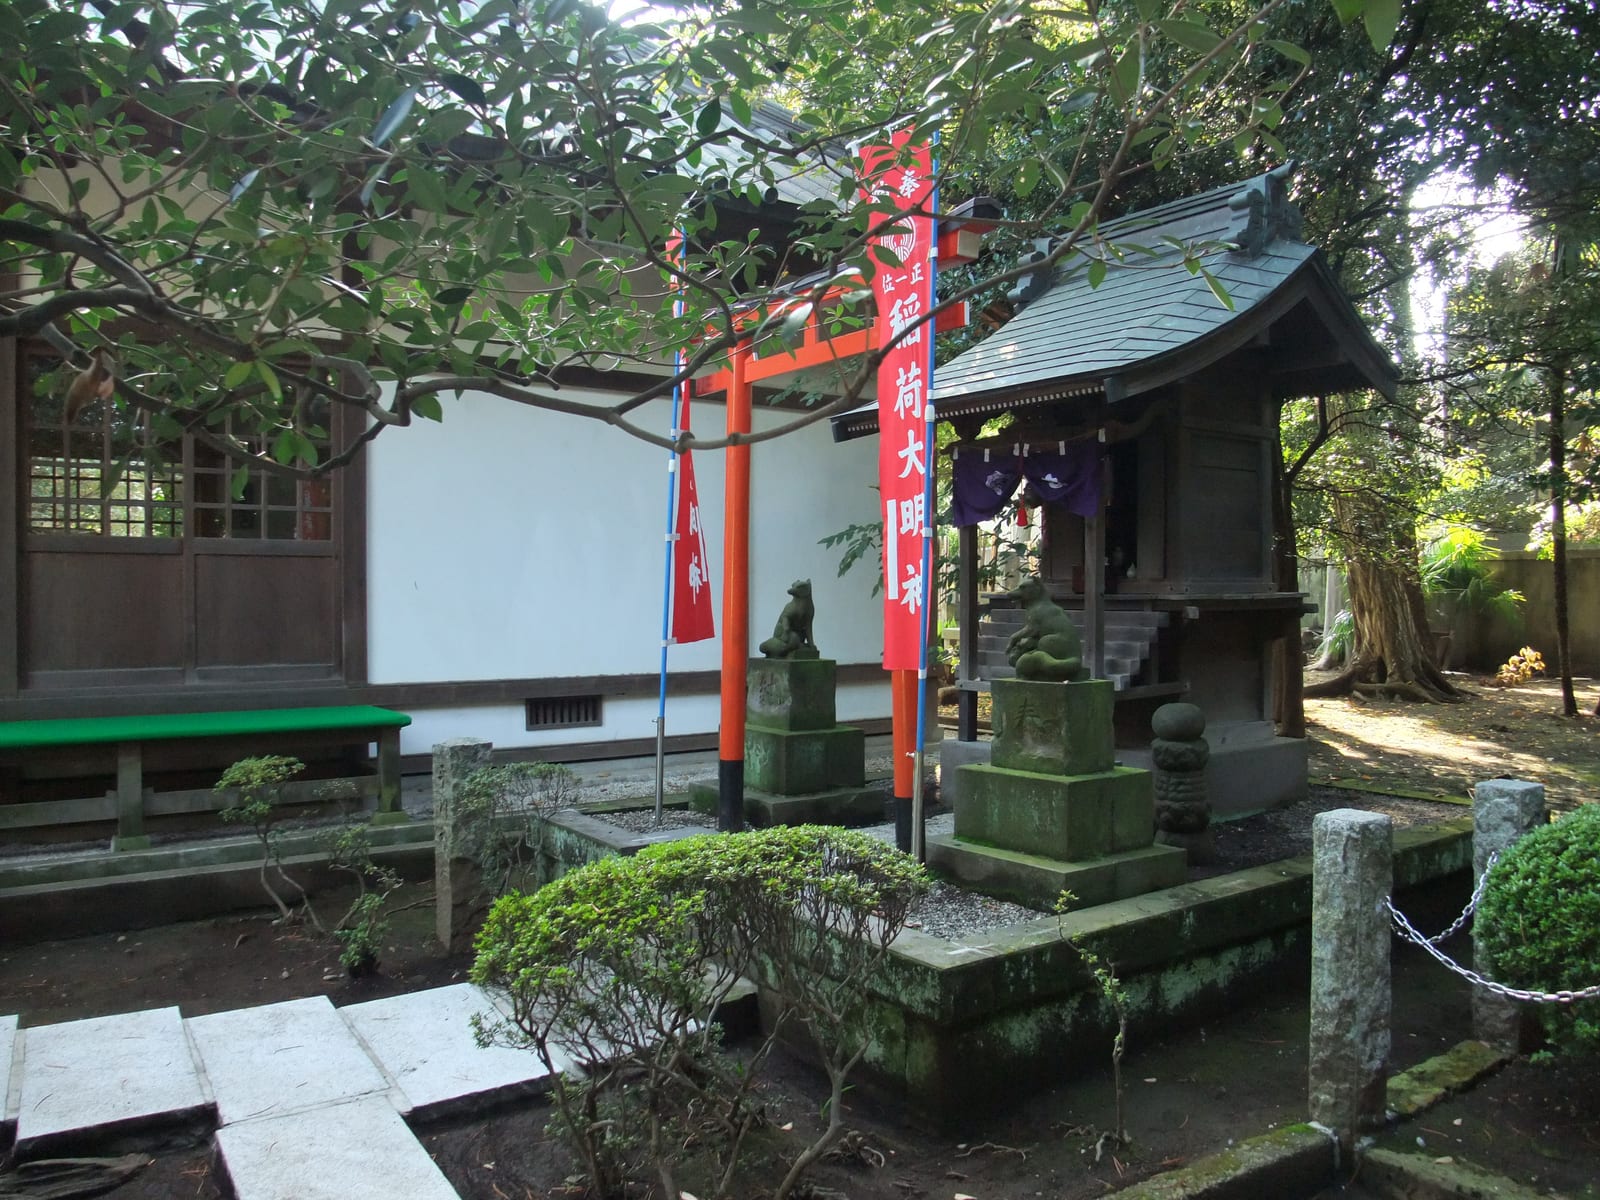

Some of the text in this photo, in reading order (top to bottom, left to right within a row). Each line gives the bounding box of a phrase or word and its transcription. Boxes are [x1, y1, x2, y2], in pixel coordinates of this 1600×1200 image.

[889, 292, 925, 614] 稲荷大明神
